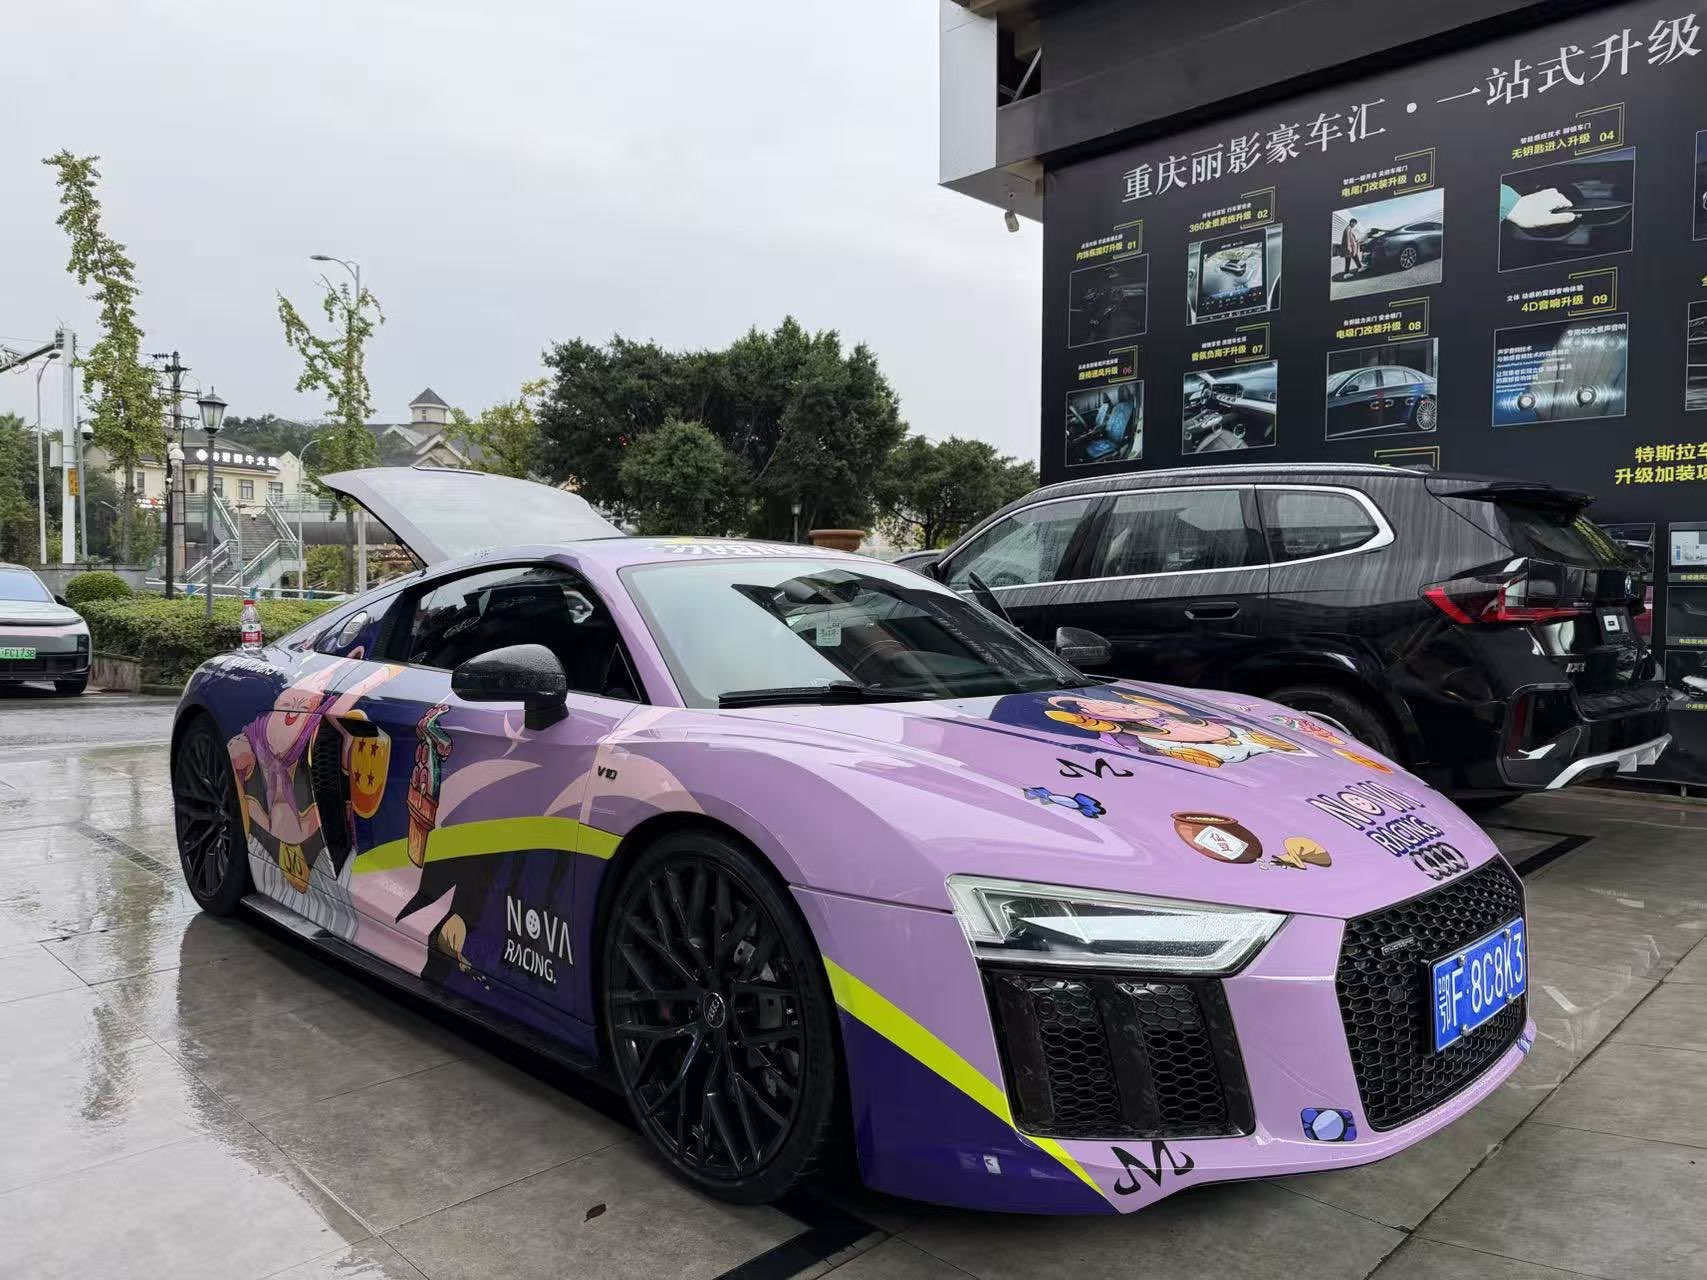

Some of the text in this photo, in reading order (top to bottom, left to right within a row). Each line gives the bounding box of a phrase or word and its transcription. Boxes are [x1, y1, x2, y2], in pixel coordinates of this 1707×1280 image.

[1599, 131, 1615, 142] 04
[1512, 133, 1591, 159] 无钥匙进入升级
[1414, 173, 1427, 183] 03
[1341, 175, 1408, 197] 电尾门改装升级
[1257, 209, 1269, 219] 02
[1127, 241, 1136, 250] 01
[1521, 295, 1584, 312] 4D音响升级
[1592, 294, 1607, 305] 09
[1408, 321, 1421, 331] 08
[1252, 344, 1263, 354] 07
[1122, 367, 1132, 376] 06
[597, 765, 618, 781] V10
